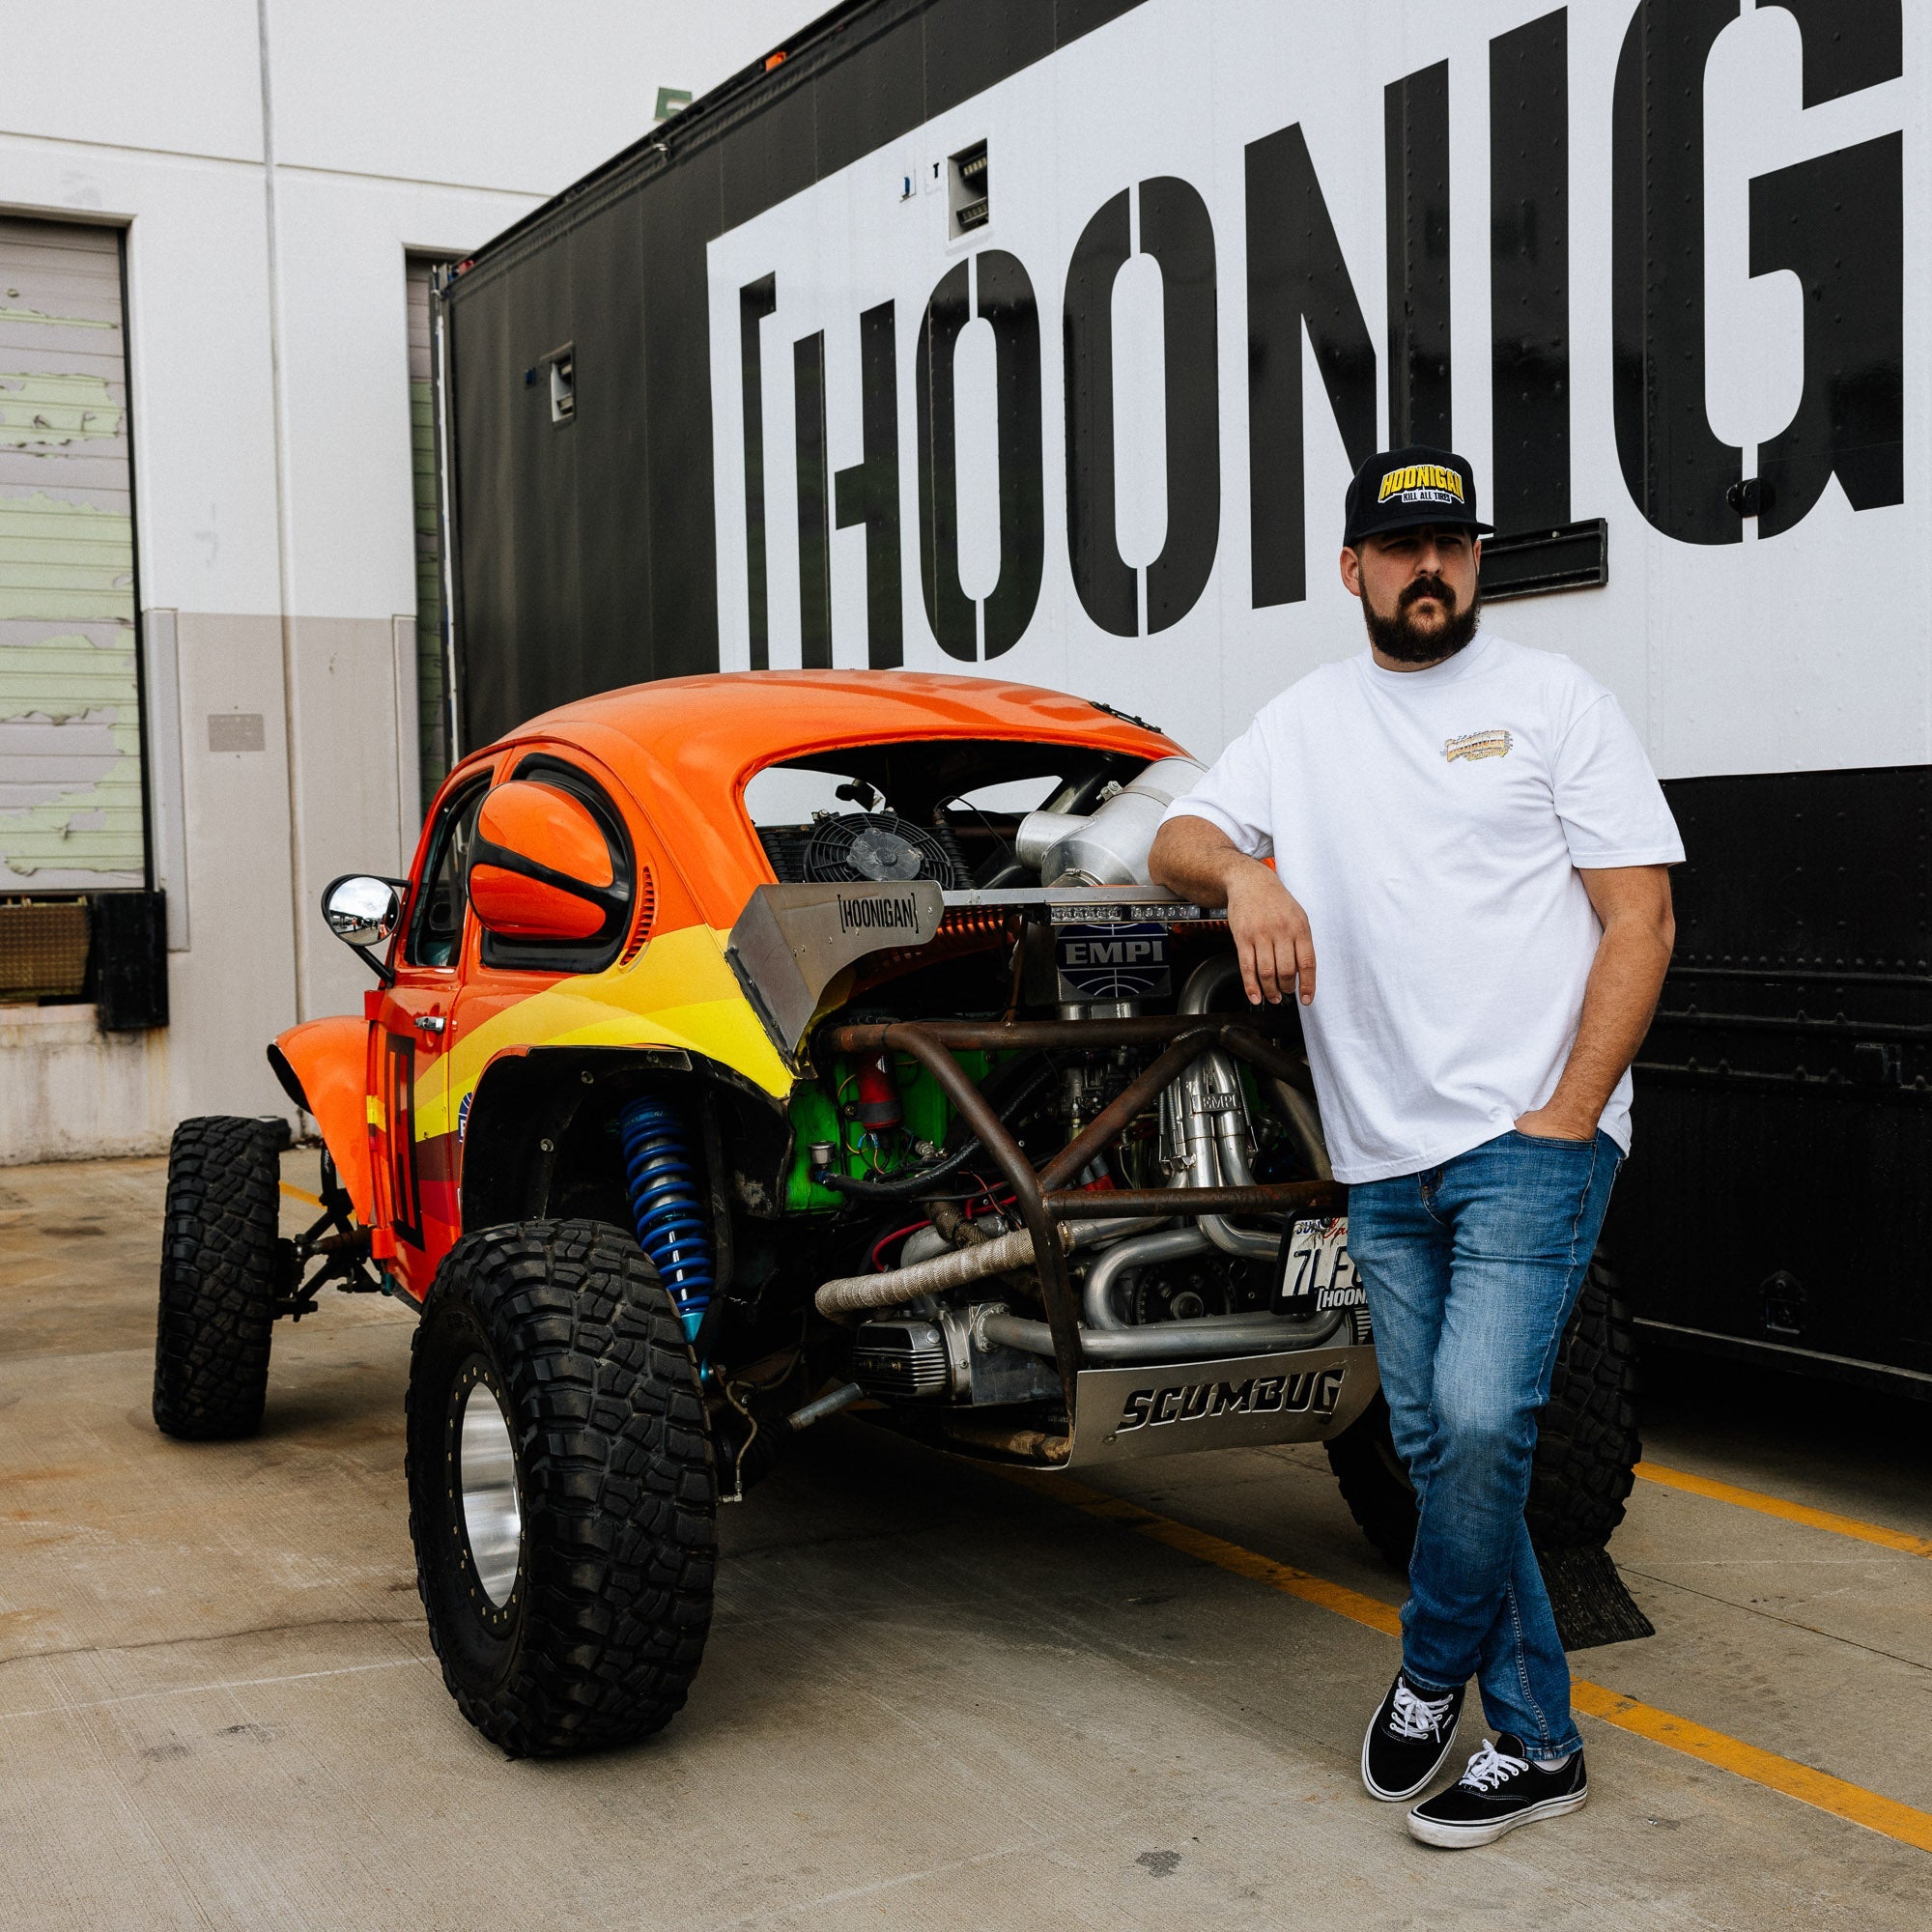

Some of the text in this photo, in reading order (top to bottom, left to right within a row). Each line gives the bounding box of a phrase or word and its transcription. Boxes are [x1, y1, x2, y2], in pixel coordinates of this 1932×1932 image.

[1379, 466, 1463, 500] HOONIGAN
[1403, 491, 1451, 502] KILL ALL TIRES
[1065, 941, 1163, 965] EMPI
[1203, 1094, 1237, 1109] EMPI
[1317, 1288, 1369, 1312] [HOON
[1115, 1369, 1346, 1434] SCUMBUG
